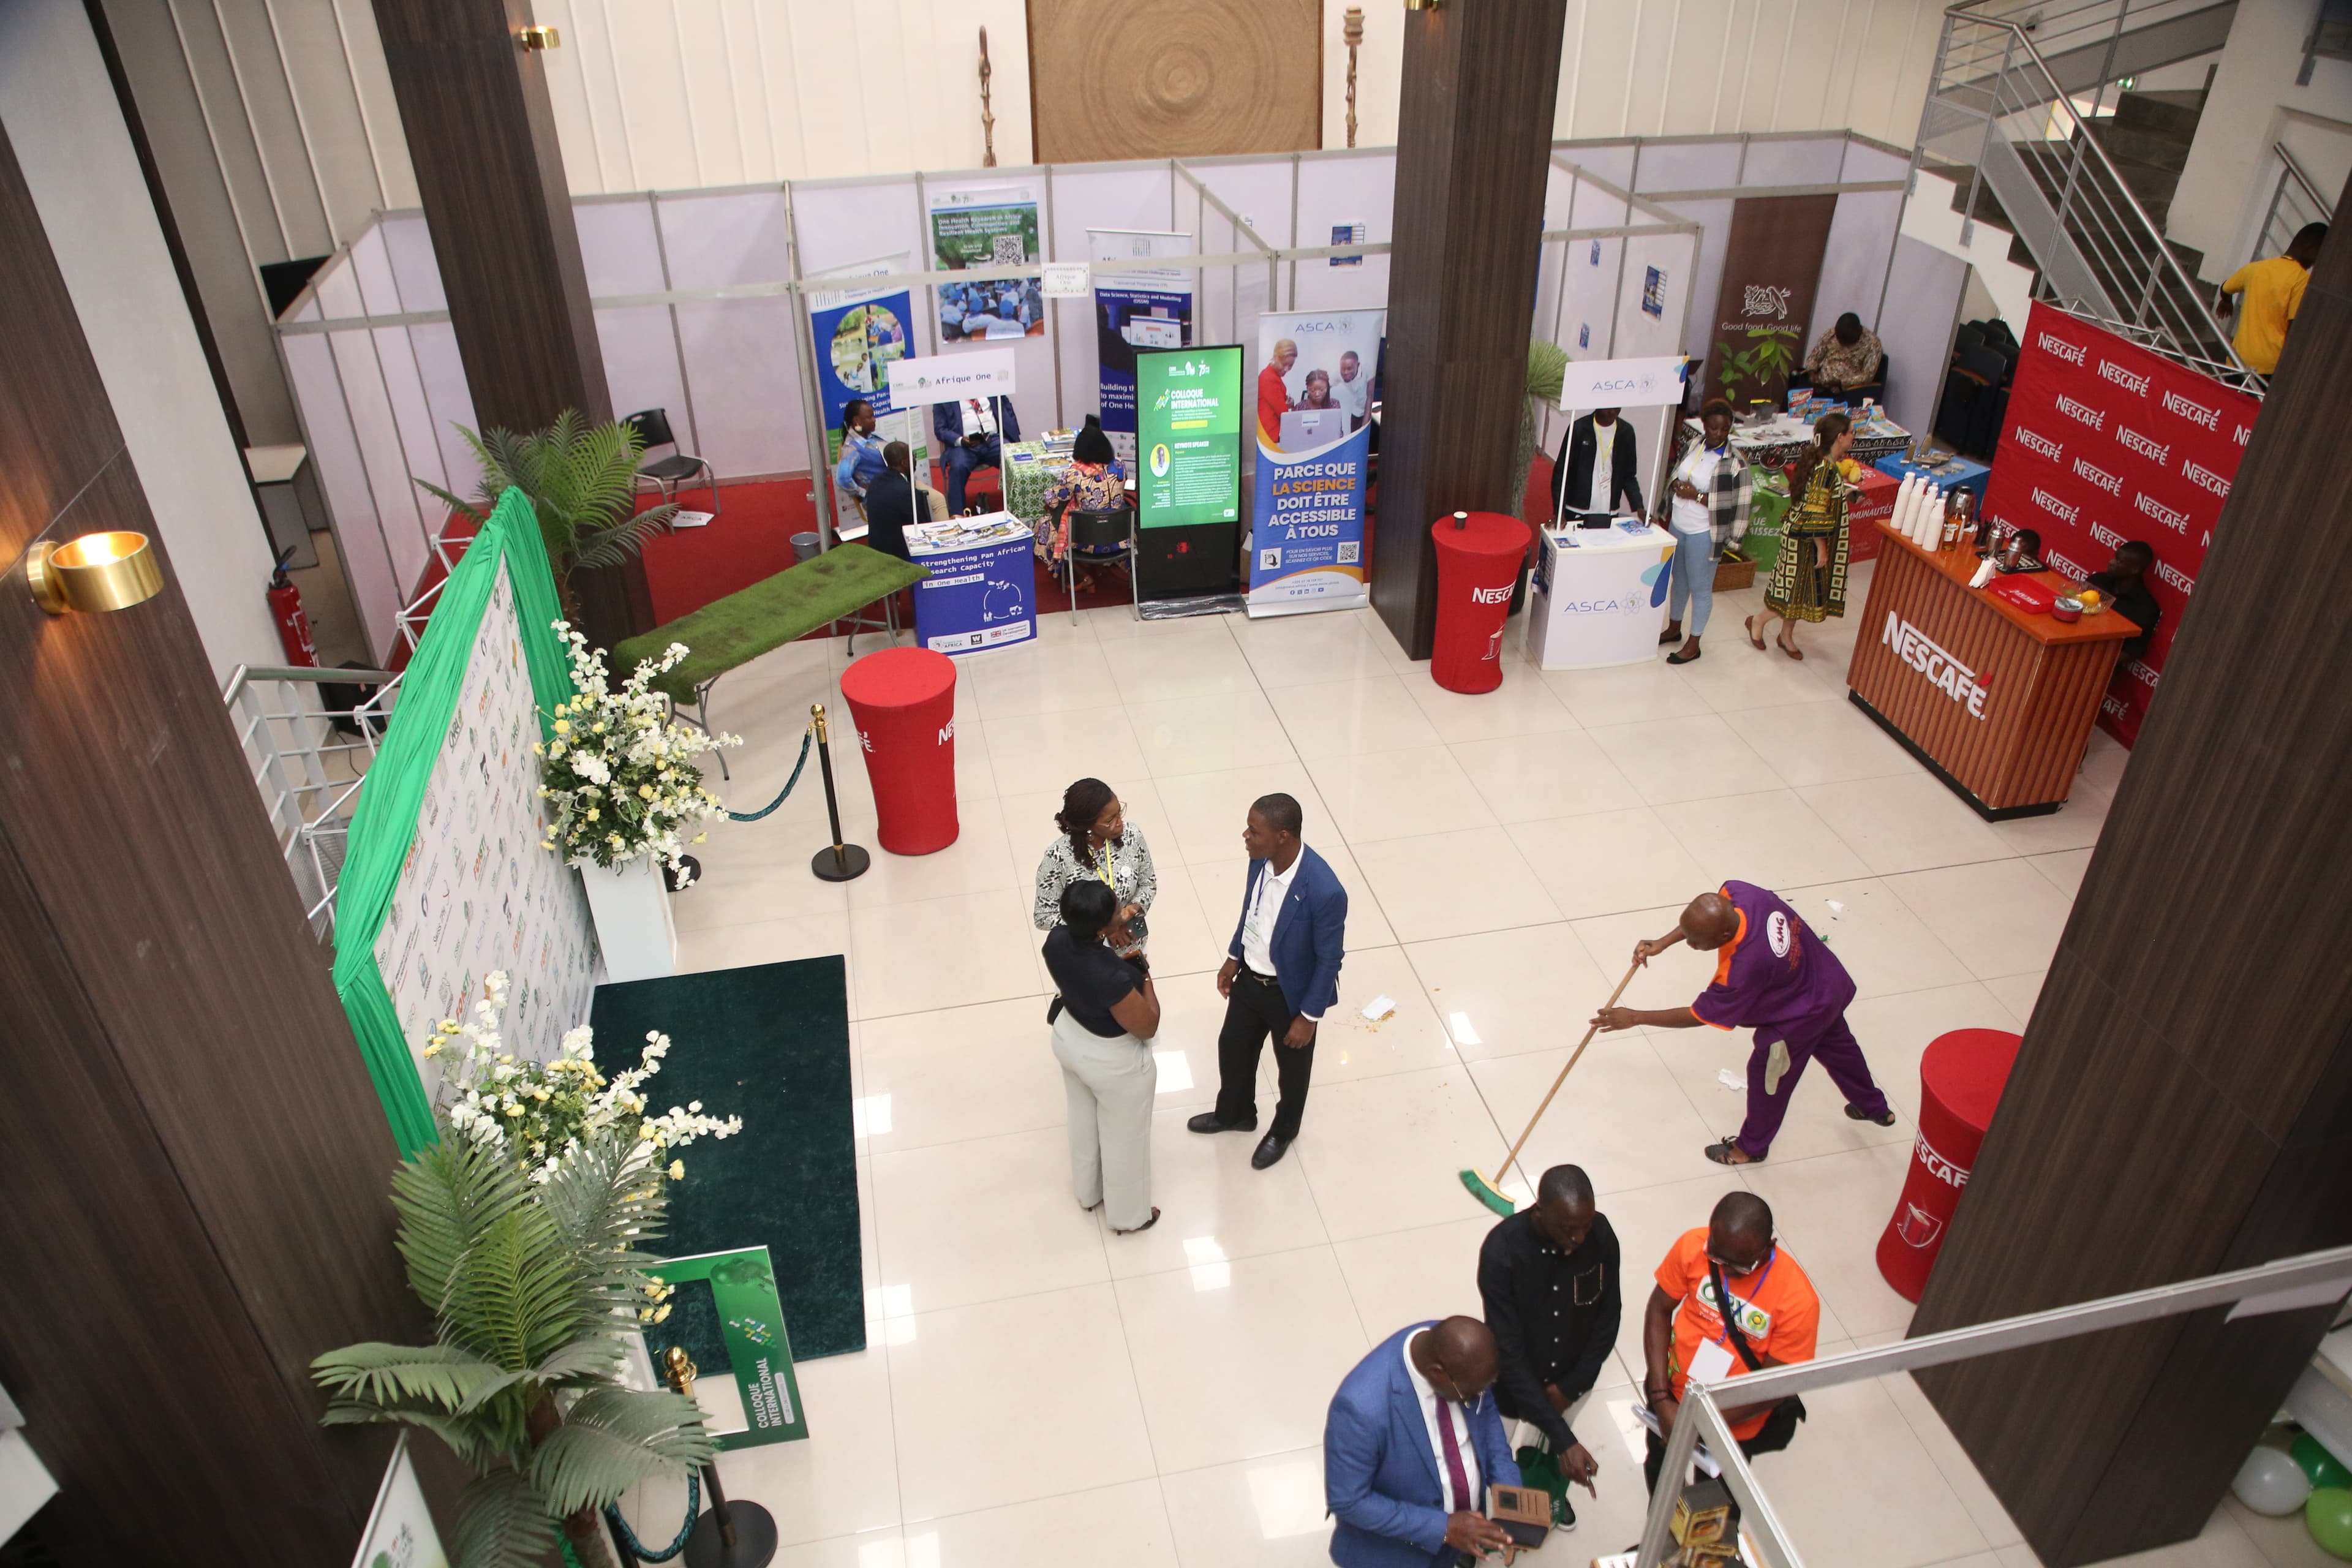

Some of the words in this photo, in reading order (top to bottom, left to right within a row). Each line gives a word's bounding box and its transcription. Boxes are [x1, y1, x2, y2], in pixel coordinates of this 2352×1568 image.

[873, 269, 889, 277] One
[1295, 322, 1335, 333] ASCA
[2038, 331, 2087, 368] NESCAFÉ
[936, 375, 971, 385] Afrique
[1101, 383, 1127, 391] Building
[1593, 380, 1635, 392] ASCA
[2098, 359, 2150, 398] NESCAFÉ
[1170, 388, 1204, 399] COLLOQUE
[1170, 398, 1219, 410] INTERNATIONAL
[873, 407, 891, 416] Health
[2055, 393, 2105, 432] NESCAFÉ
[2162, 390, 2221, 432] NESCAFÉ
[2015, 426, 2063, 463] NESCAFÉ
[2116, 424, 2170, 466] NESCAFÉ
[1274, 464, 1323, 480] PARCE
[1325, 462, 1356, 477] QUE
[2073, 457, 2124, 497] NESCAFÉ
[2182, 459, 2231, 499] NESCAF
[1273, 483, 1290, 496] LA
[1292, 478, 1356, 494] SCIENCE
[1277, 496, 1313, 511] DOIT
[1314, 492, 1349, 507] ÊTRE
[1849, 504, 1893, 521] MMUNAUTÉS
[2032, 487, 2080, 527] NESCAFÉ
[1268, 509, 1357, 527] ACCESSIBLE
[2135, 491, 2190, 535] NESCAFÉ
[1286, 524, 1297, 540] À
[1298, 524, 1339, 538] TOUS
[2090, 521, 2127, 550] NESC
[921, 556, 978, 567] Strengthening
[997, 545, 1026, 556] African
[960, 560, 995, 571] Capacity
[2046, 549, 2089, 582] NESCAF
[954, 575, 981, 584] Health
[2154, 559, 2195, 596] NESCA
[1472, 578, 1517, 604] NESCA
[1564, 600, 1619, 613] ASCA
[1915, 1125, 1970, 1188] ESCAF
[756, 1357, 782, 1427] INTERNATIONAL
[748, 1383, 769, 1428] COLLOQUE
